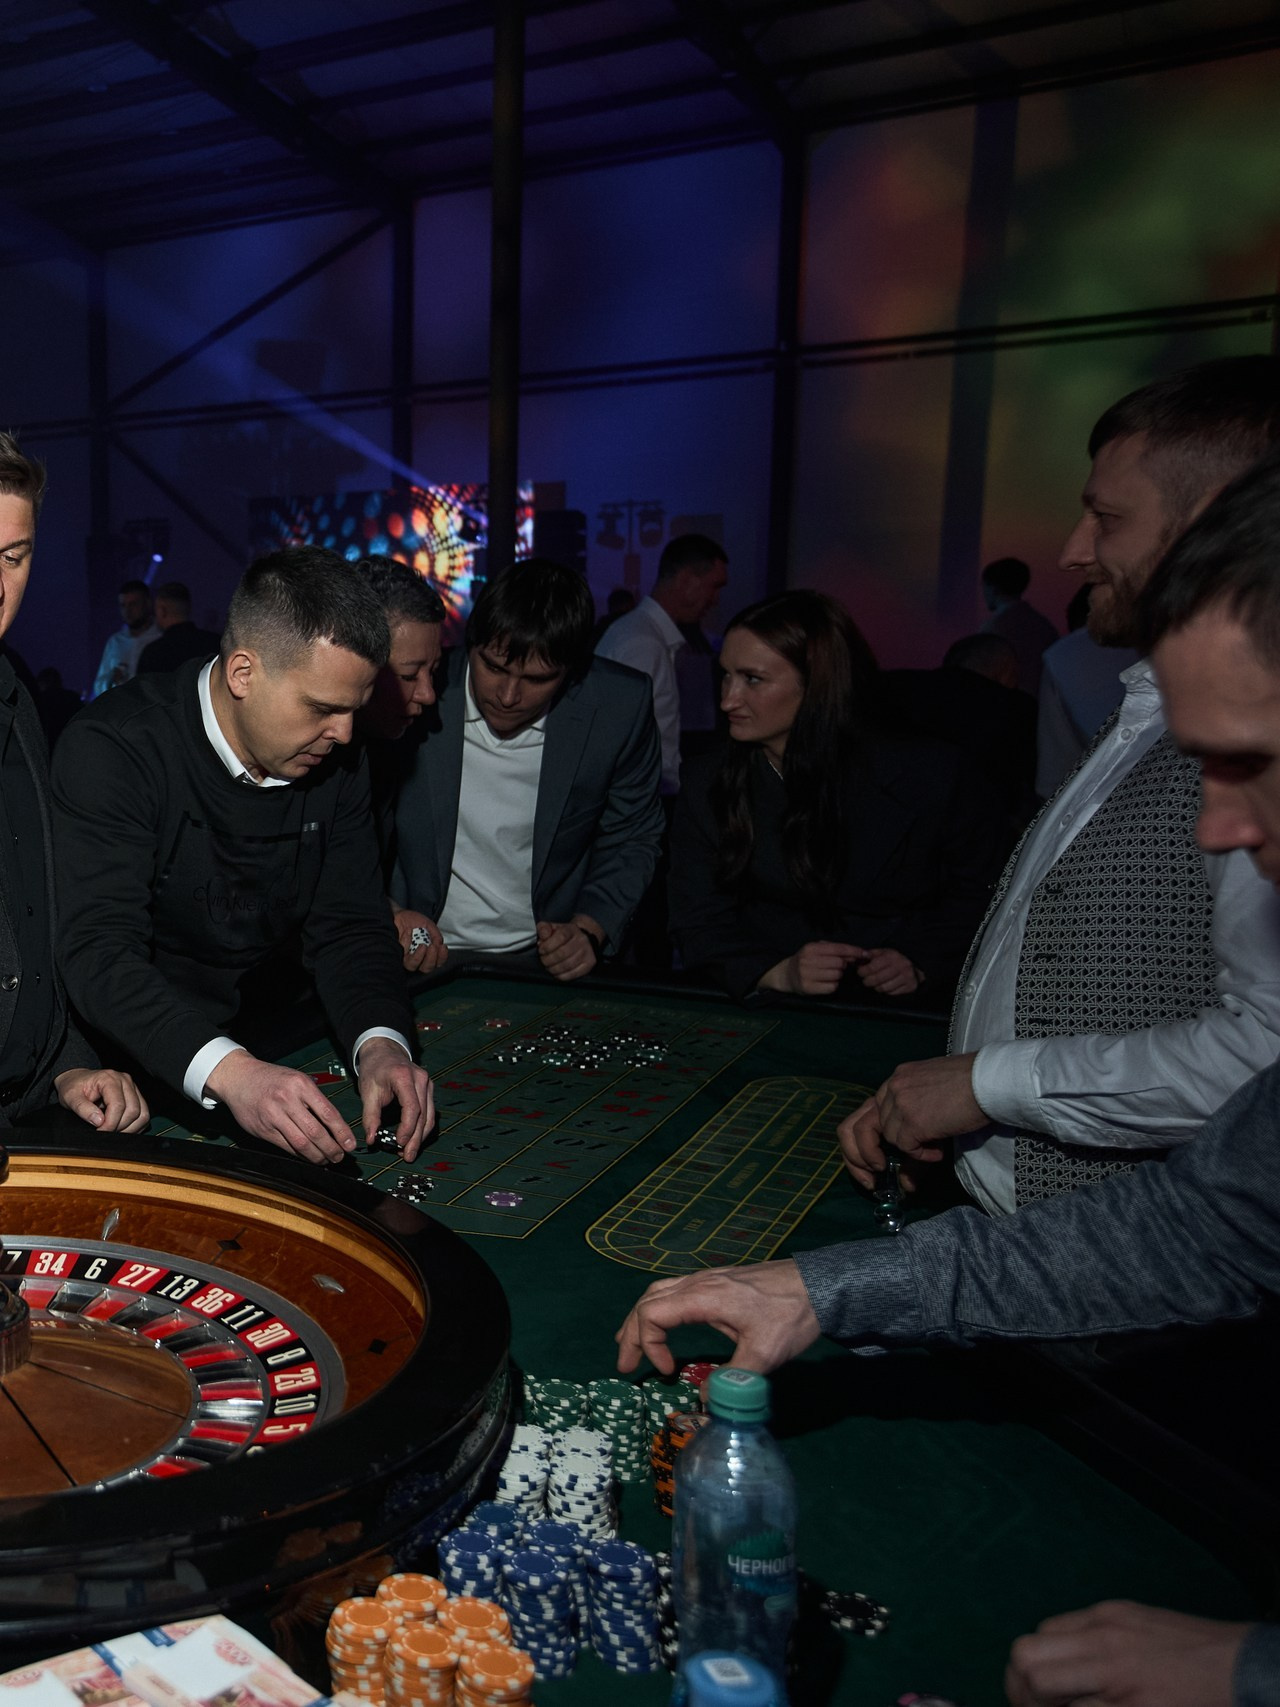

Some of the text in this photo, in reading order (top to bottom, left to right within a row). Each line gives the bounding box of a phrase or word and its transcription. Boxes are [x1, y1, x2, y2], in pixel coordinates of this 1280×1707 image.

[193, 886, 229, 908] Cvin
[33, 1252, 67, 1275] 34
[84, 1258, 107, 1280] 6
[118, 1263, 160, 1288] 27
[156, 1274, 200, 1300] 13
[191, 1287, 235, 1314] 36
[221, 1304, 264, 1330] 11
[246, 1321, 291, 1348] 30
[266, 1346, 306, 1364] 8
[274, 1367, 317, 1391] 23
[274, 1393, 317, 1415] 10
[263, 1420, 307, 1436] 5
